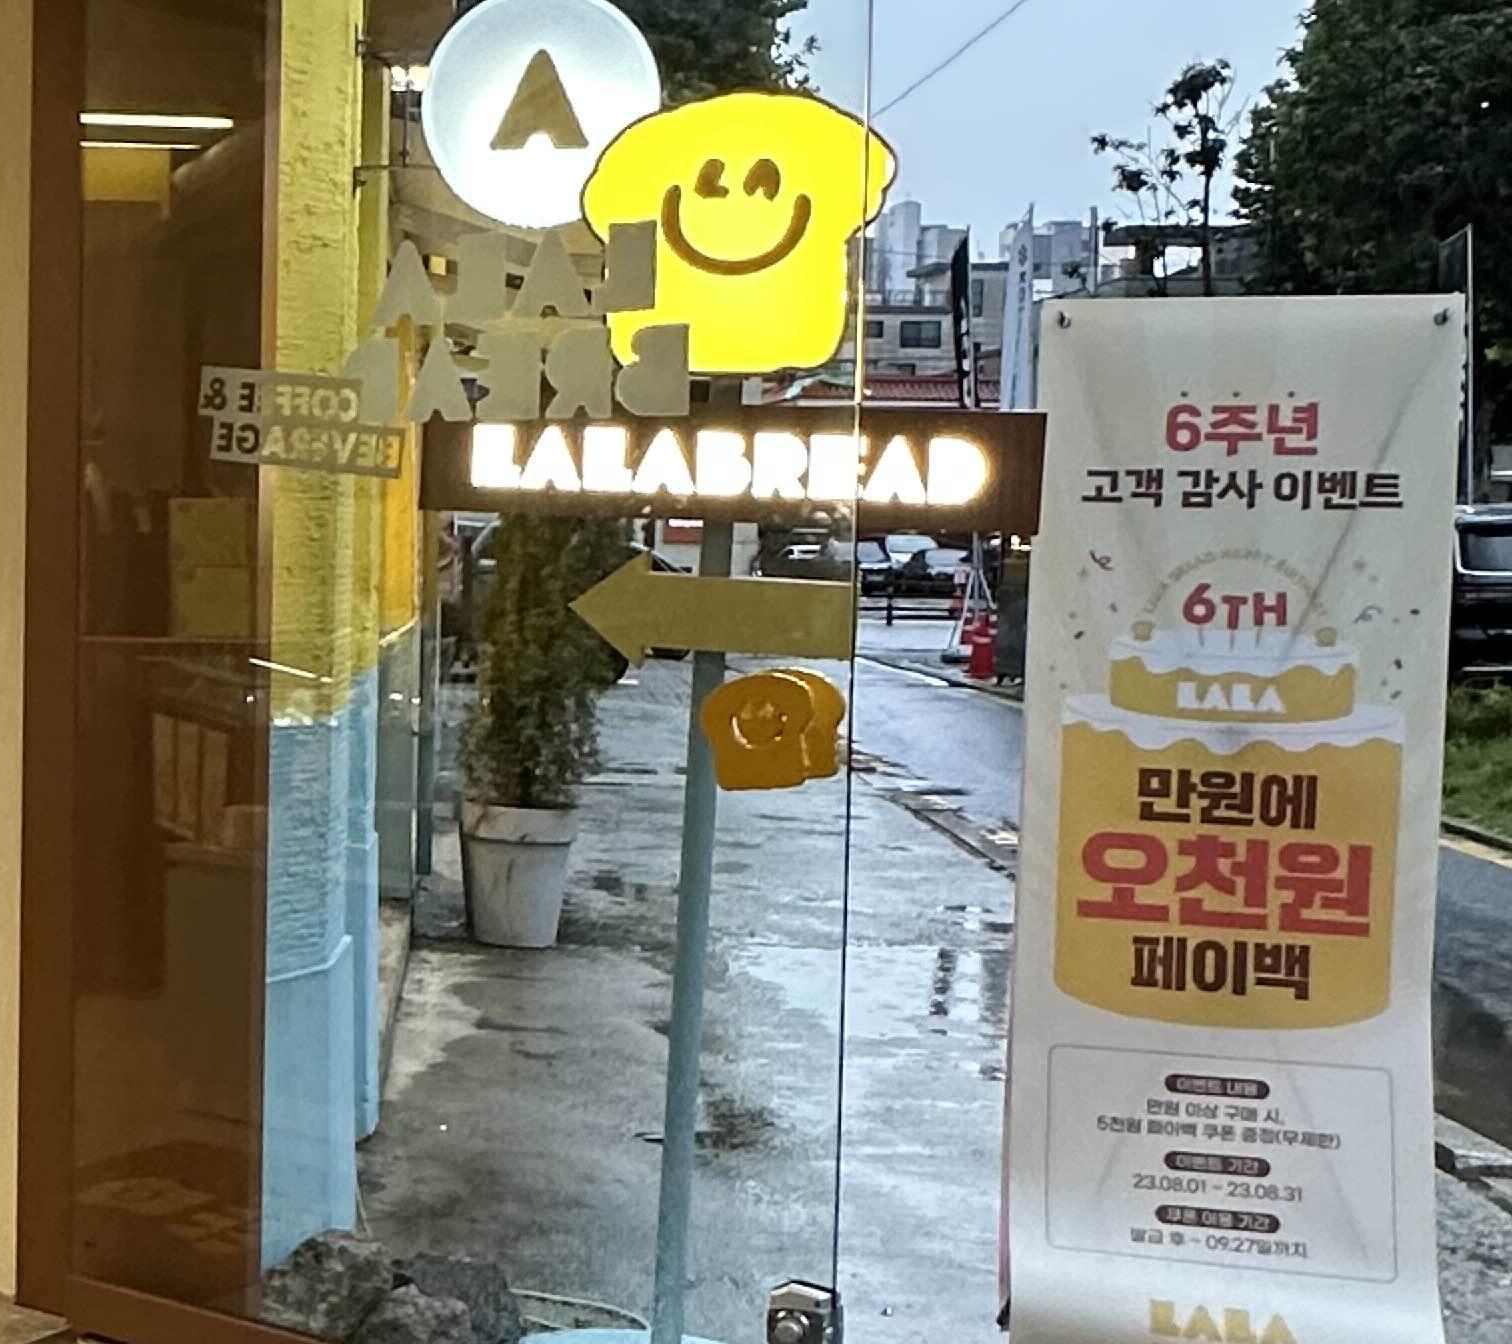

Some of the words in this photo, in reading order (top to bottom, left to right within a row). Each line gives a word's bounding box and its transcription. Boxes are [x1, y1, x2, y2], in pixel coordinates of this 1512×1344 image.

[1164, 402, 1320, 457] 6주년
[470, 423, 989, 507] LALABREAD
[1081, 468, 1164, 507] 고객
[1177, 469, 1264, 510] 감사
[1273, 470, 1404, 511] 이벤트
[1182, 583, 1288, 631] 6TH
[1176, 681, 1288, 714] LALA
[1137, 767, 1319, 830] 만원에
[1076, 830, 1373, 938] 오천원
[1130, 935, 1312, 1001] 페이백
